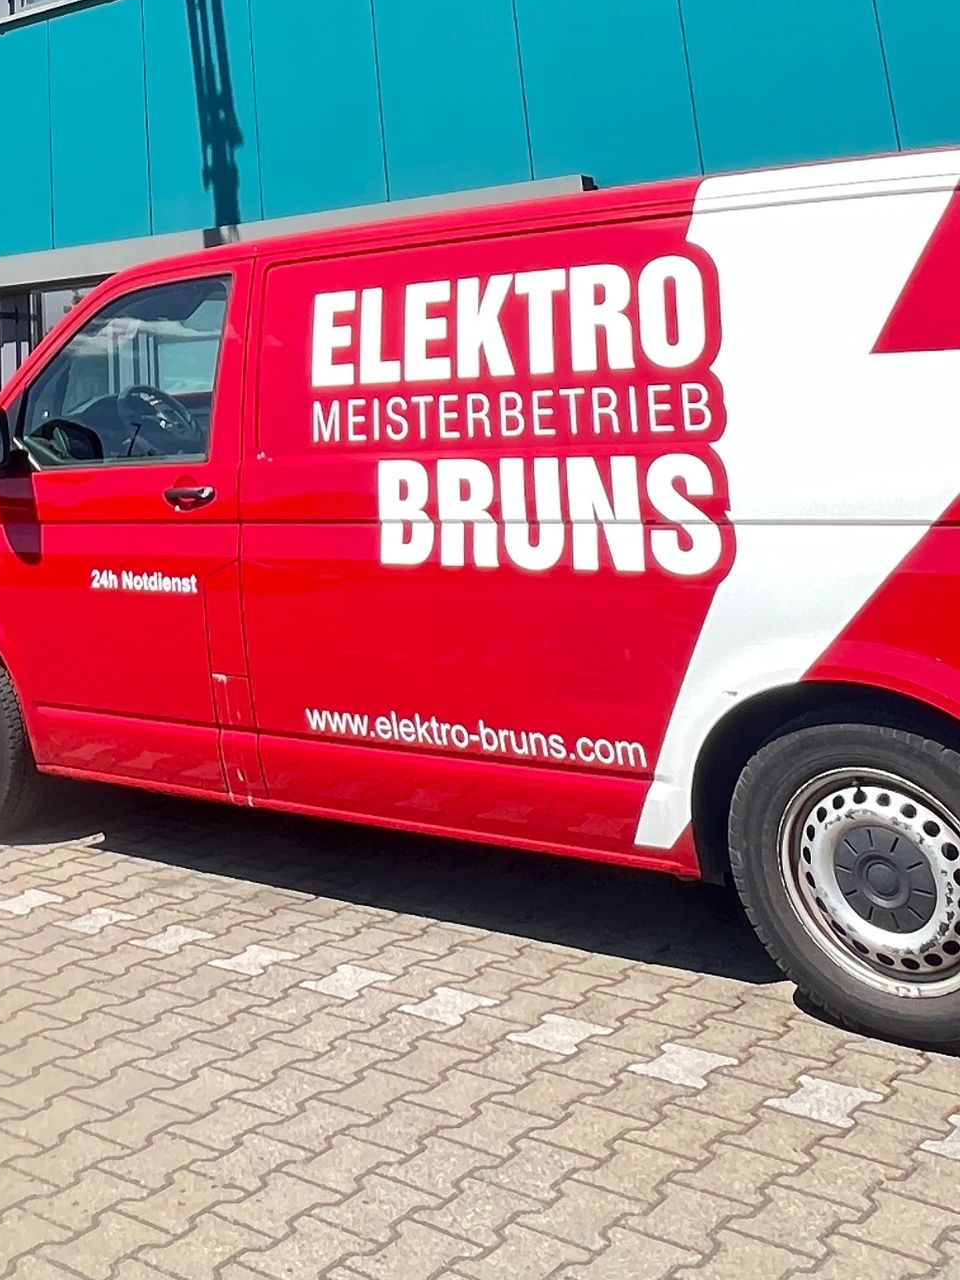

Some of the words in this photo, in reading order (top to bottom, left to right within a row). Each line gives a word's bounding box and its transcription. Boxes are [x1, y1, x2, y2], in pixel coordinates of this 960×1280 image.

[310, 254, 707, 388] ELEKTRO
[312, 382, 713, 443] MEISTERBETRIEB
[377, 452, 723, 577] BRUNS
[90, 568, 119, 590] 24h
[121, 570, 198, 594] Notdienst
[304, 707, 648, 768] www.elektro-bruns.com
